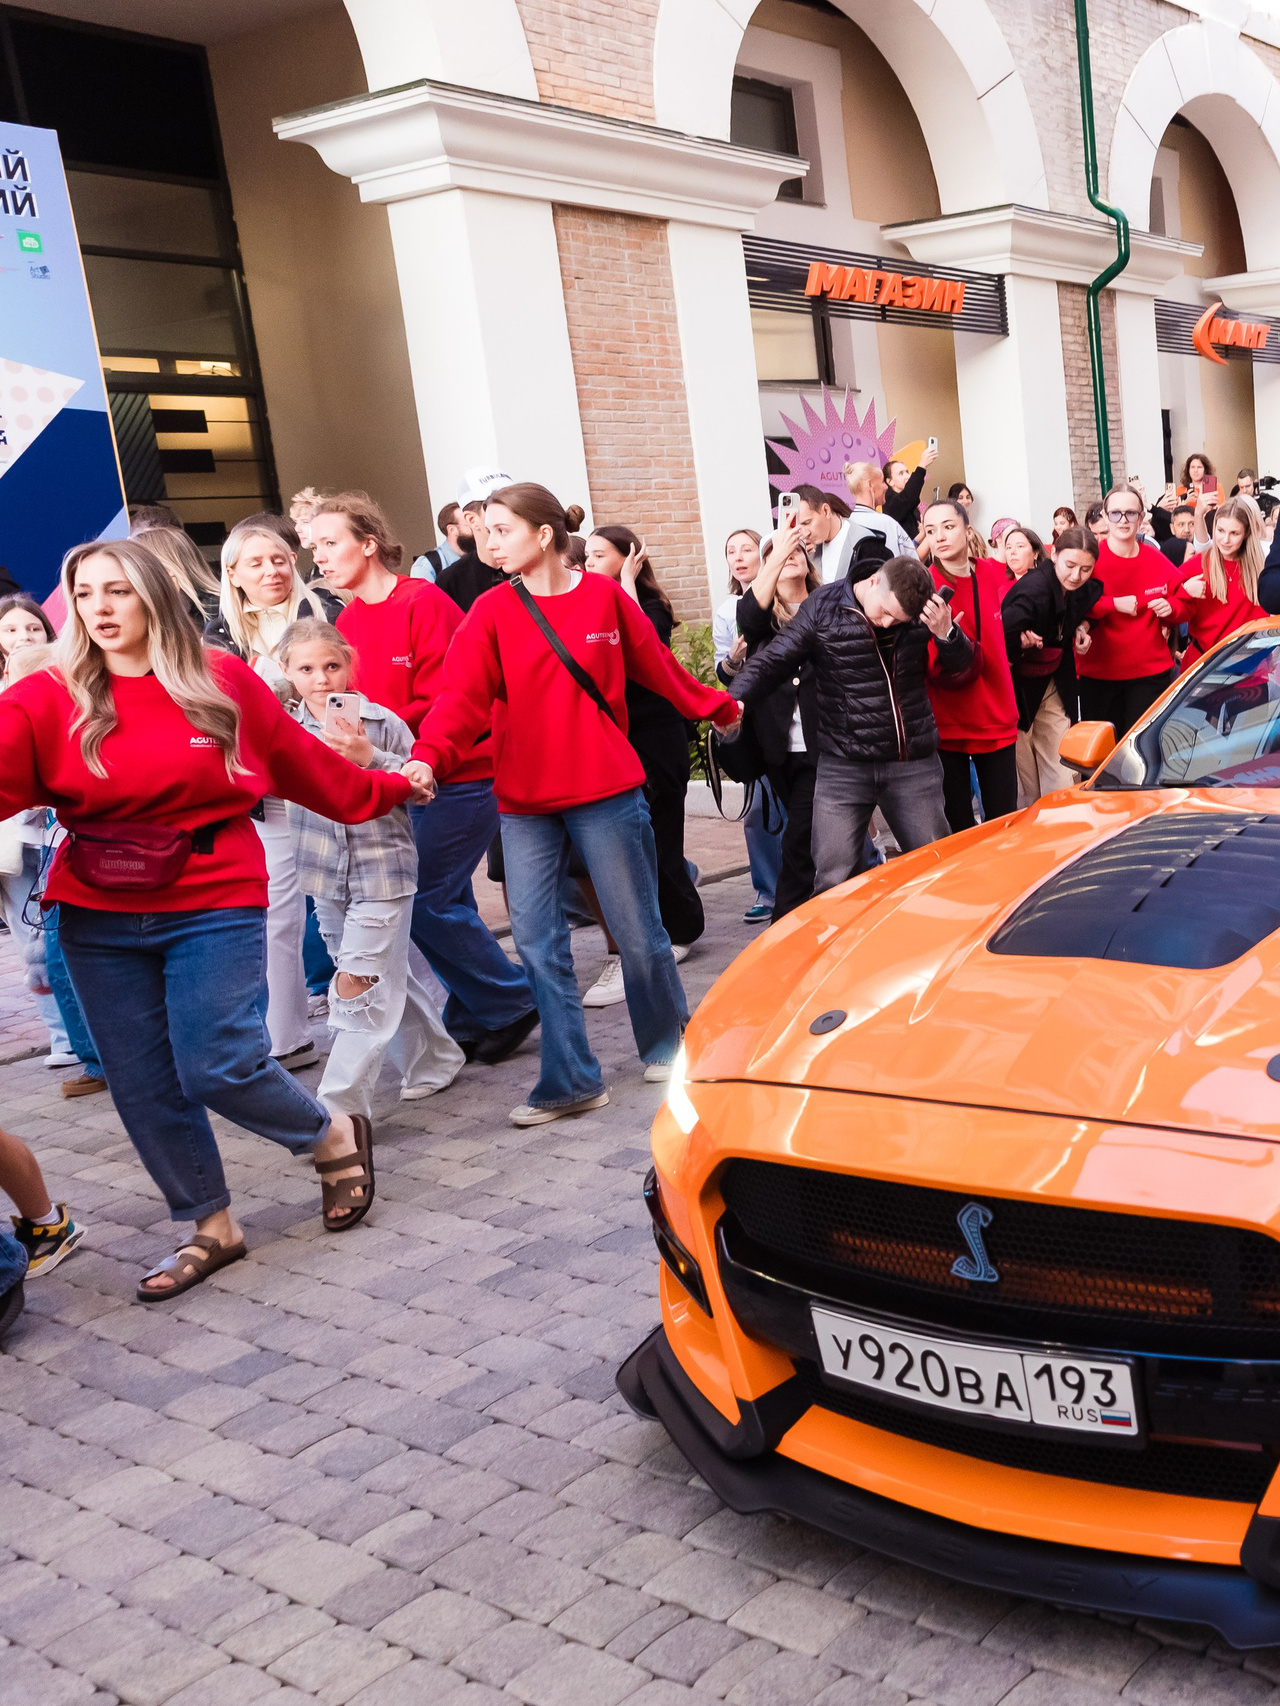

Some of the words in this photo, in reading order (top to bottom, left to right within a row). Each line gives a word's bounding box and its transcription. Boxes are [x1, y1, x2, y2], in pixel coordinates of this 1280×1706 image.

[0, 148, 30, 182] Й
[805, 262, 966, 313] МАГАЗИН
[1211, 318, 1271, 349] КАНТ
[820, 472, 846, 481] AGUT
[190, 736, 219, 744] AGUTE
[831, 1333, 1024, 1411] У920ВА
[1033, 1362, 1118, 1408] 193
[1057, 1405, 1099, 1424] RUS
